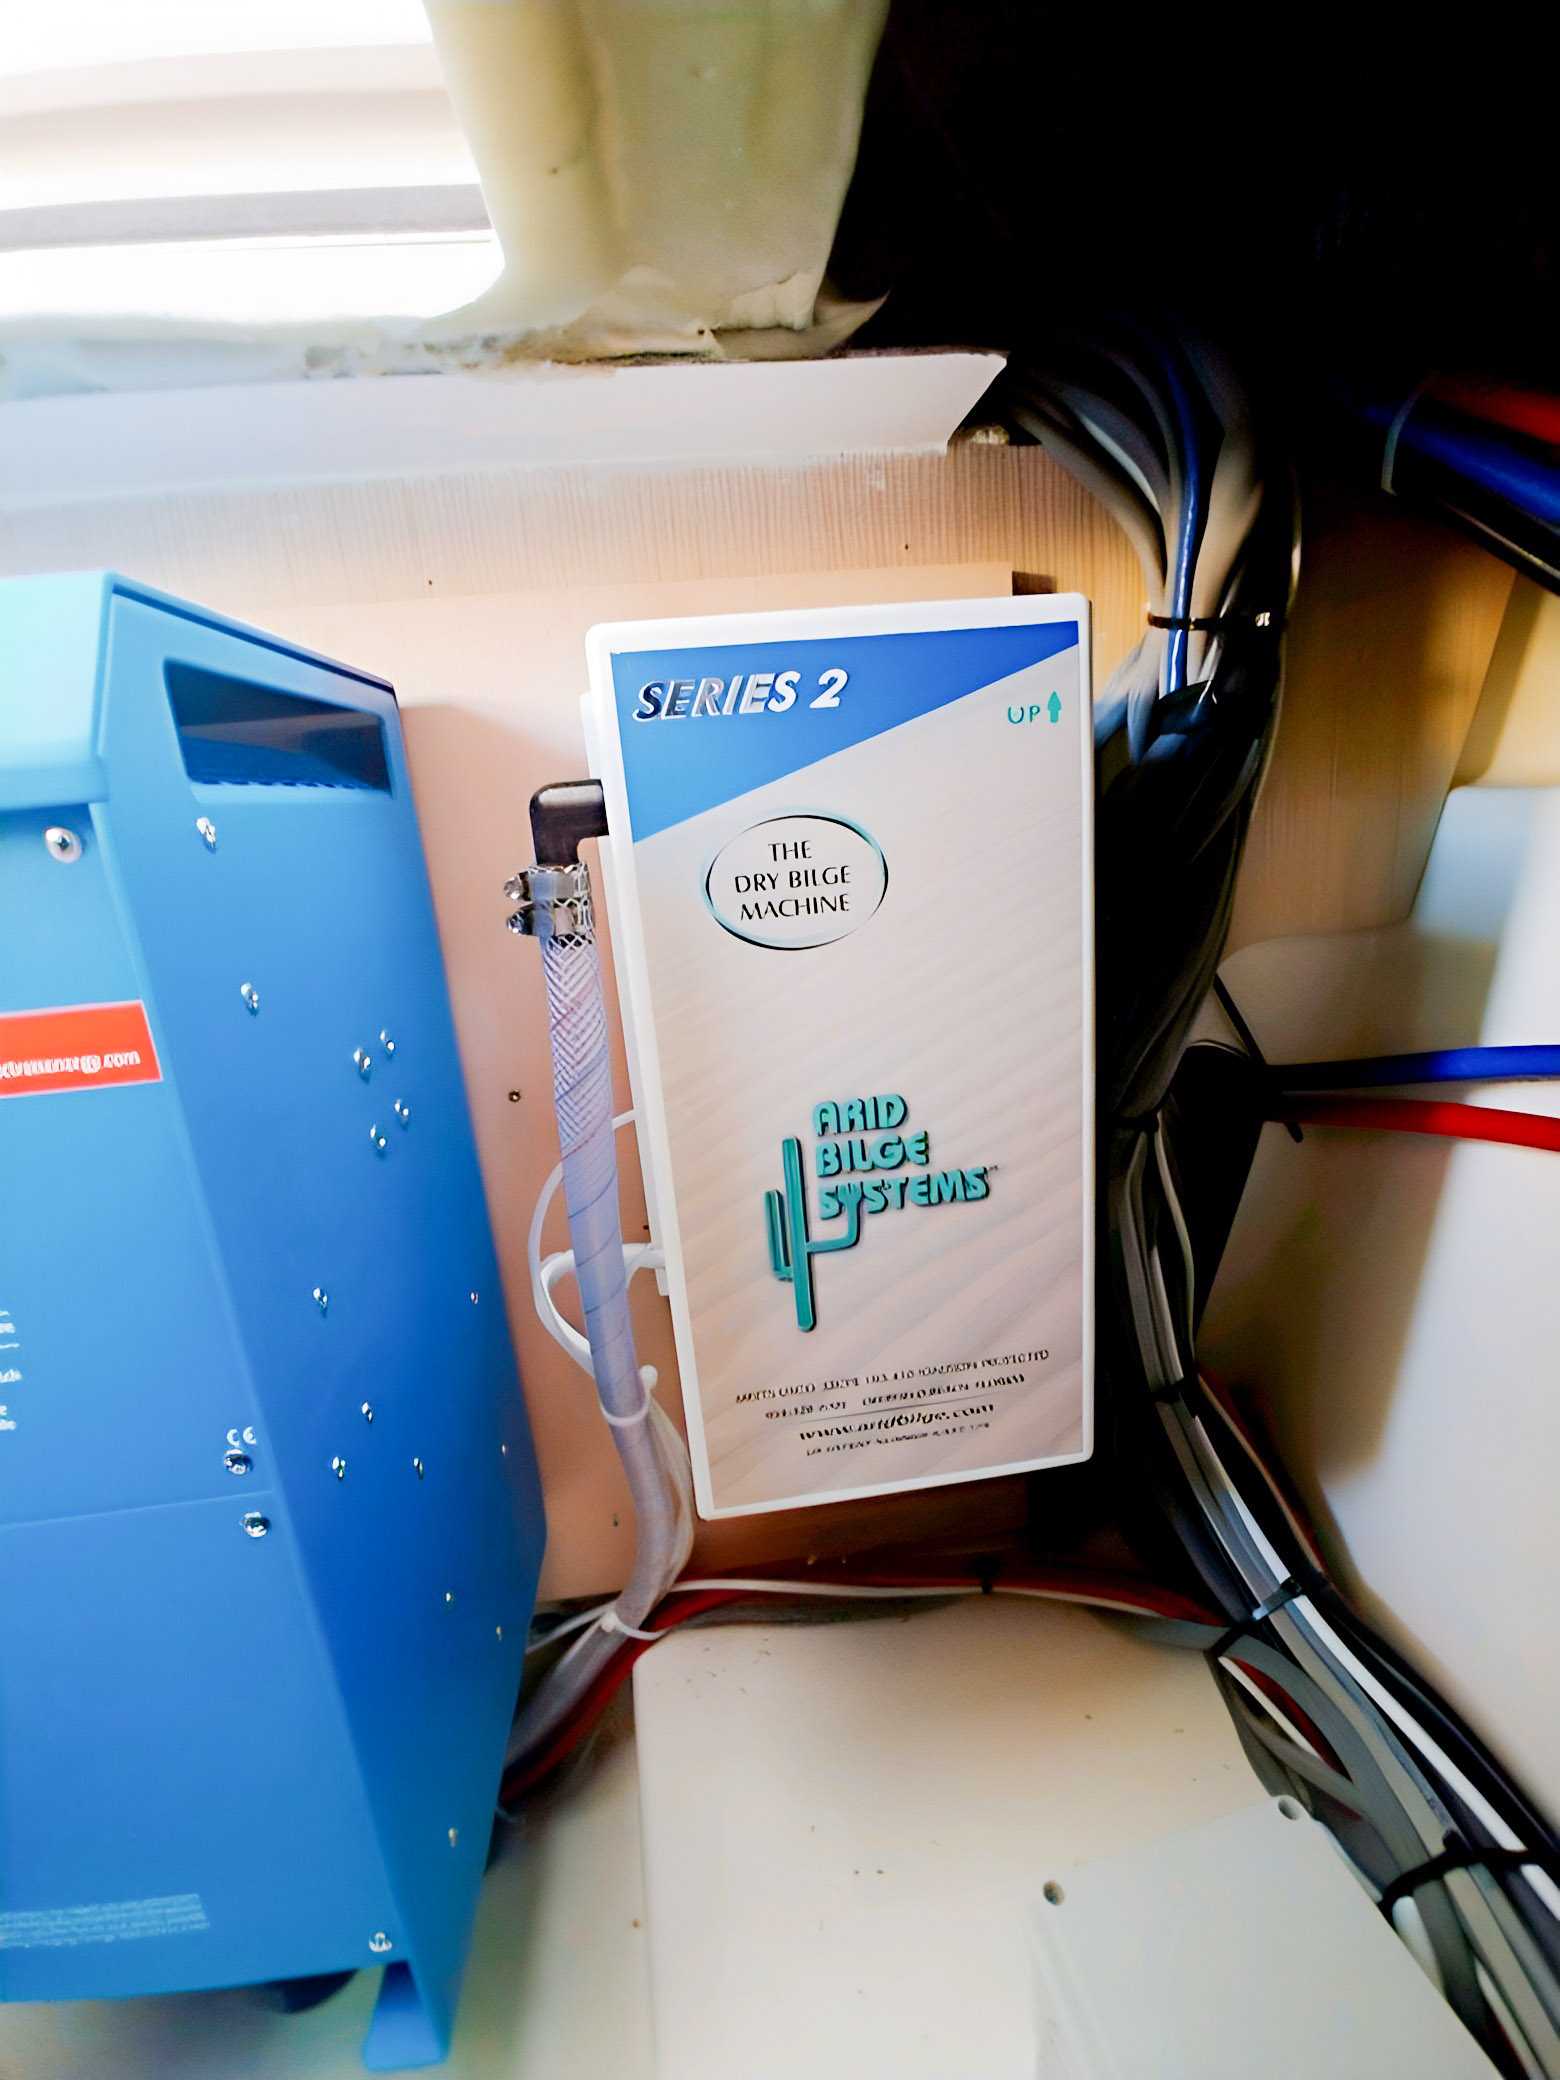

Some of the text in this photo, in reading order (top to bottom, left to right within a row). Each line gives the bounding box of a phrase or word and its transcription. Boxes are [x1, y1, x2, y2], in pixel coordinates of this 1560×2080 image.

[633, 669, 848, 722] SERIES 2
[1007, 704, 1041, 725] UP
[768, 840, 812, 862] THE
[735, 866, 851, 894] DRY BILGE
[740, 894, 850, 922] MACHINE
[813, 1094, 908, 1136] ARID
[816, 1131, 929, 1177] BILGE
[817, 1167, 989, 1220] SYSTEMS
